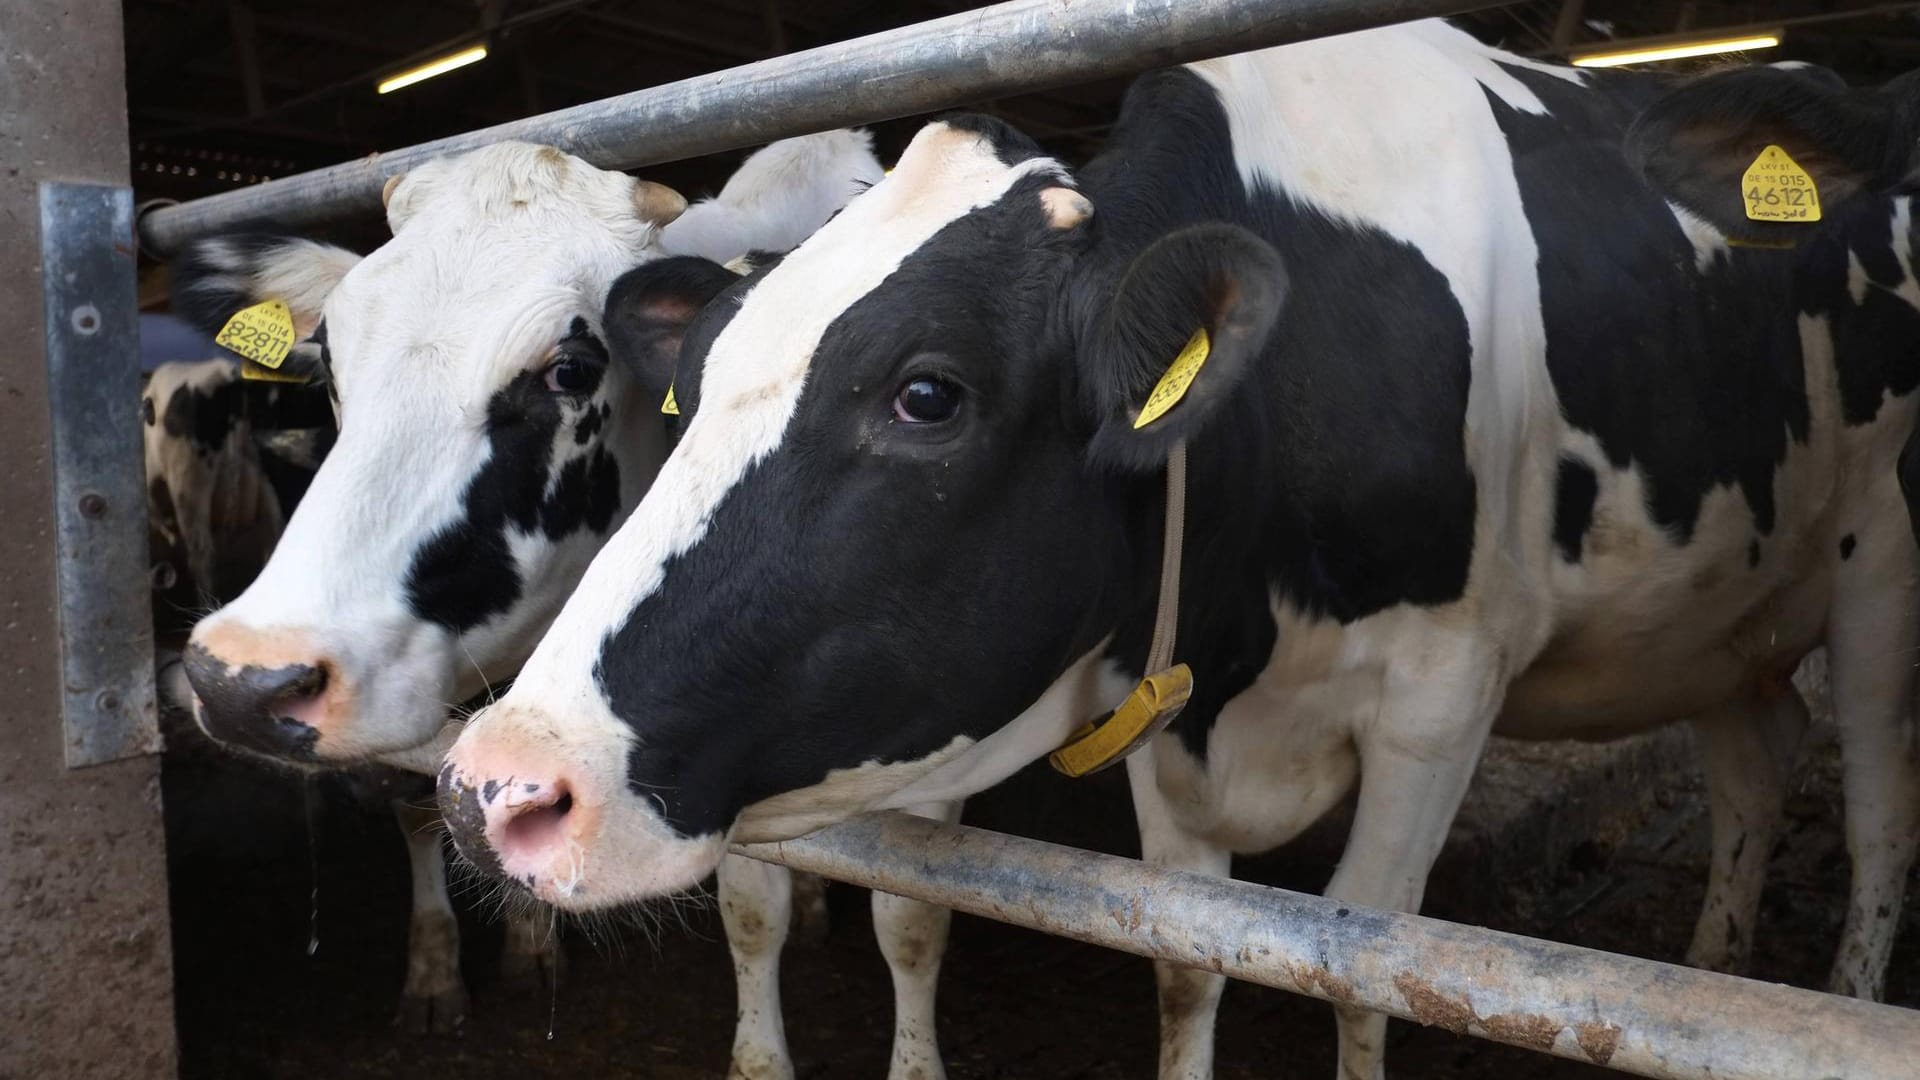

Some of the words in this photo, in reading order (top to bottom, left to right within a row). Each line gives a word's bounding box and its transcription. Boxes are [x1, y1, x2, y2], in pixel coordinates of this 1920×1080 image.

[1780, 175, 1805, 186] 015
[1747, 186, 1816, 206] 46121
[228, 320, 288, 356] 82811
[268, 322, 289, 337] 014
